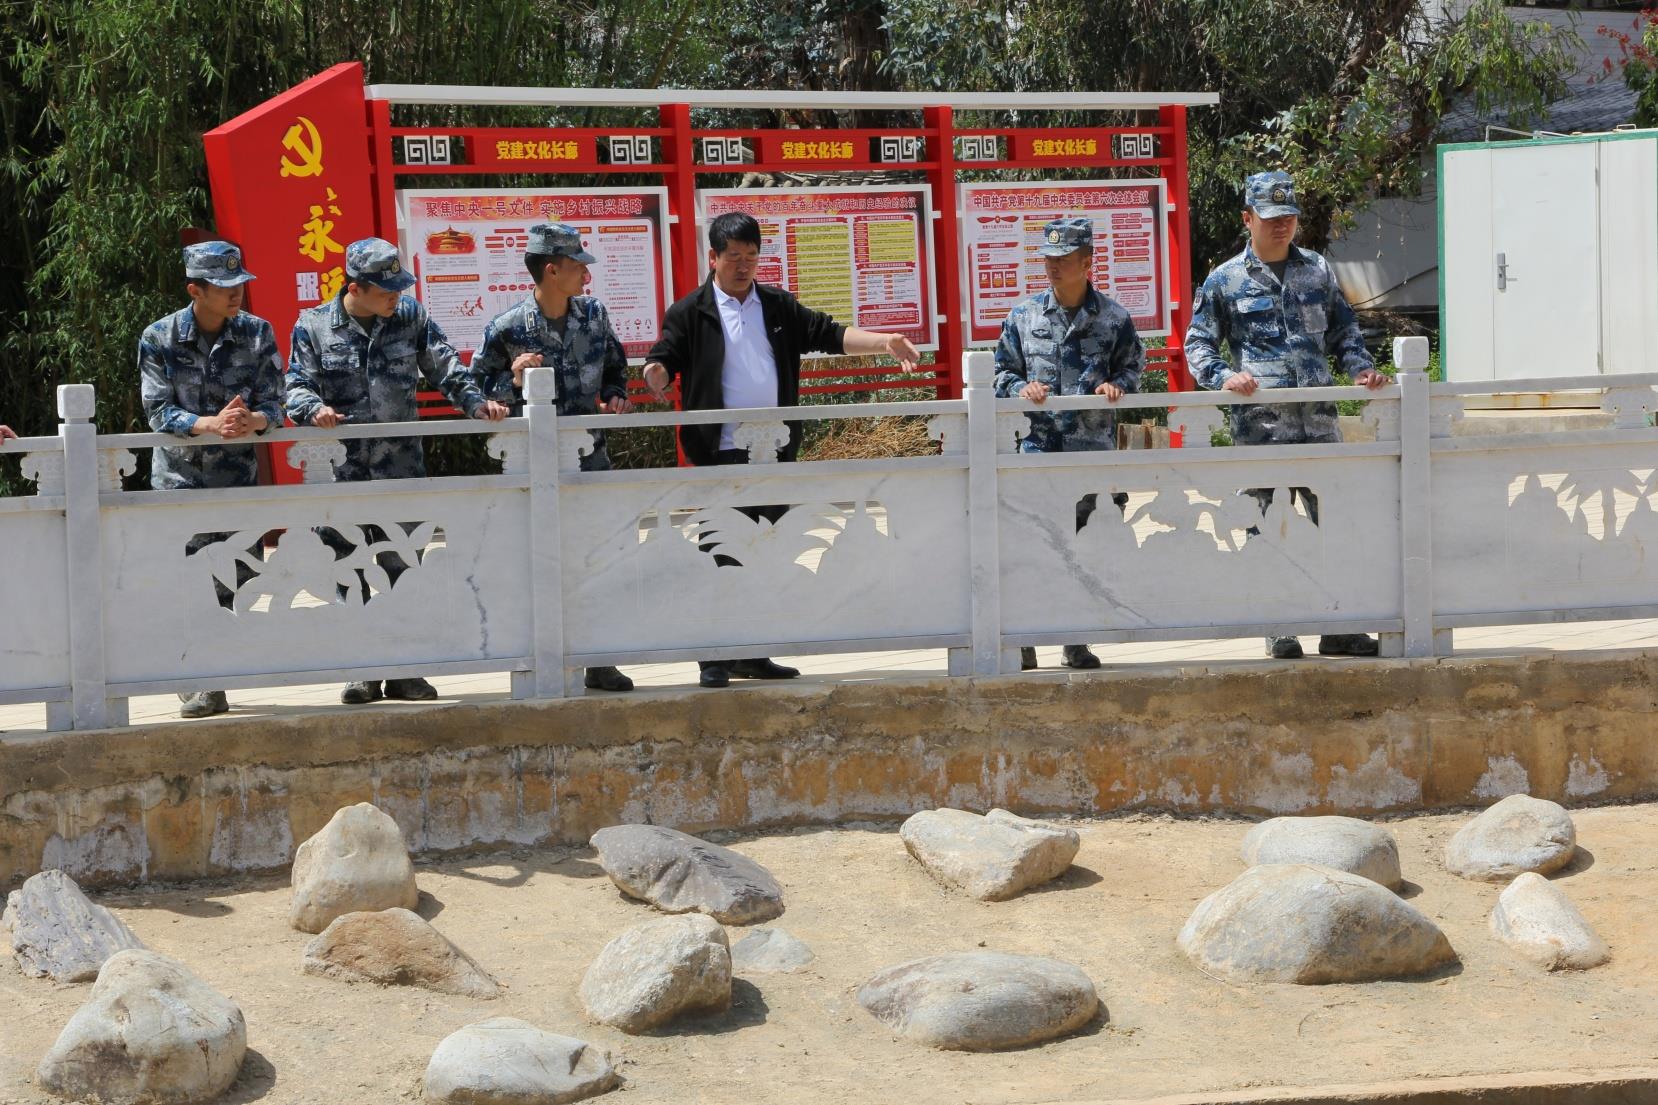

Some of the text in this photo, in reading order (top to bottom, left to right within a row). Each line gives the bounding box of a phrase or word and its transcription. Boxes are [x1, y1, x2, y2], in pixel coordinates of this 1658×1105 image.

[495, 140, 579, 161] 党建文化长廊
[781, 140, 854, 160] 党建文化长廊
[1032, 138, 1098, 157] 党建文化长廊
[425, 198, 643, 218] 聚焦中央一号文件 实施乡村振兴战略
[973, 190, 1150, 209] 中国共产党第十九届中央委员会第六次全体会议
